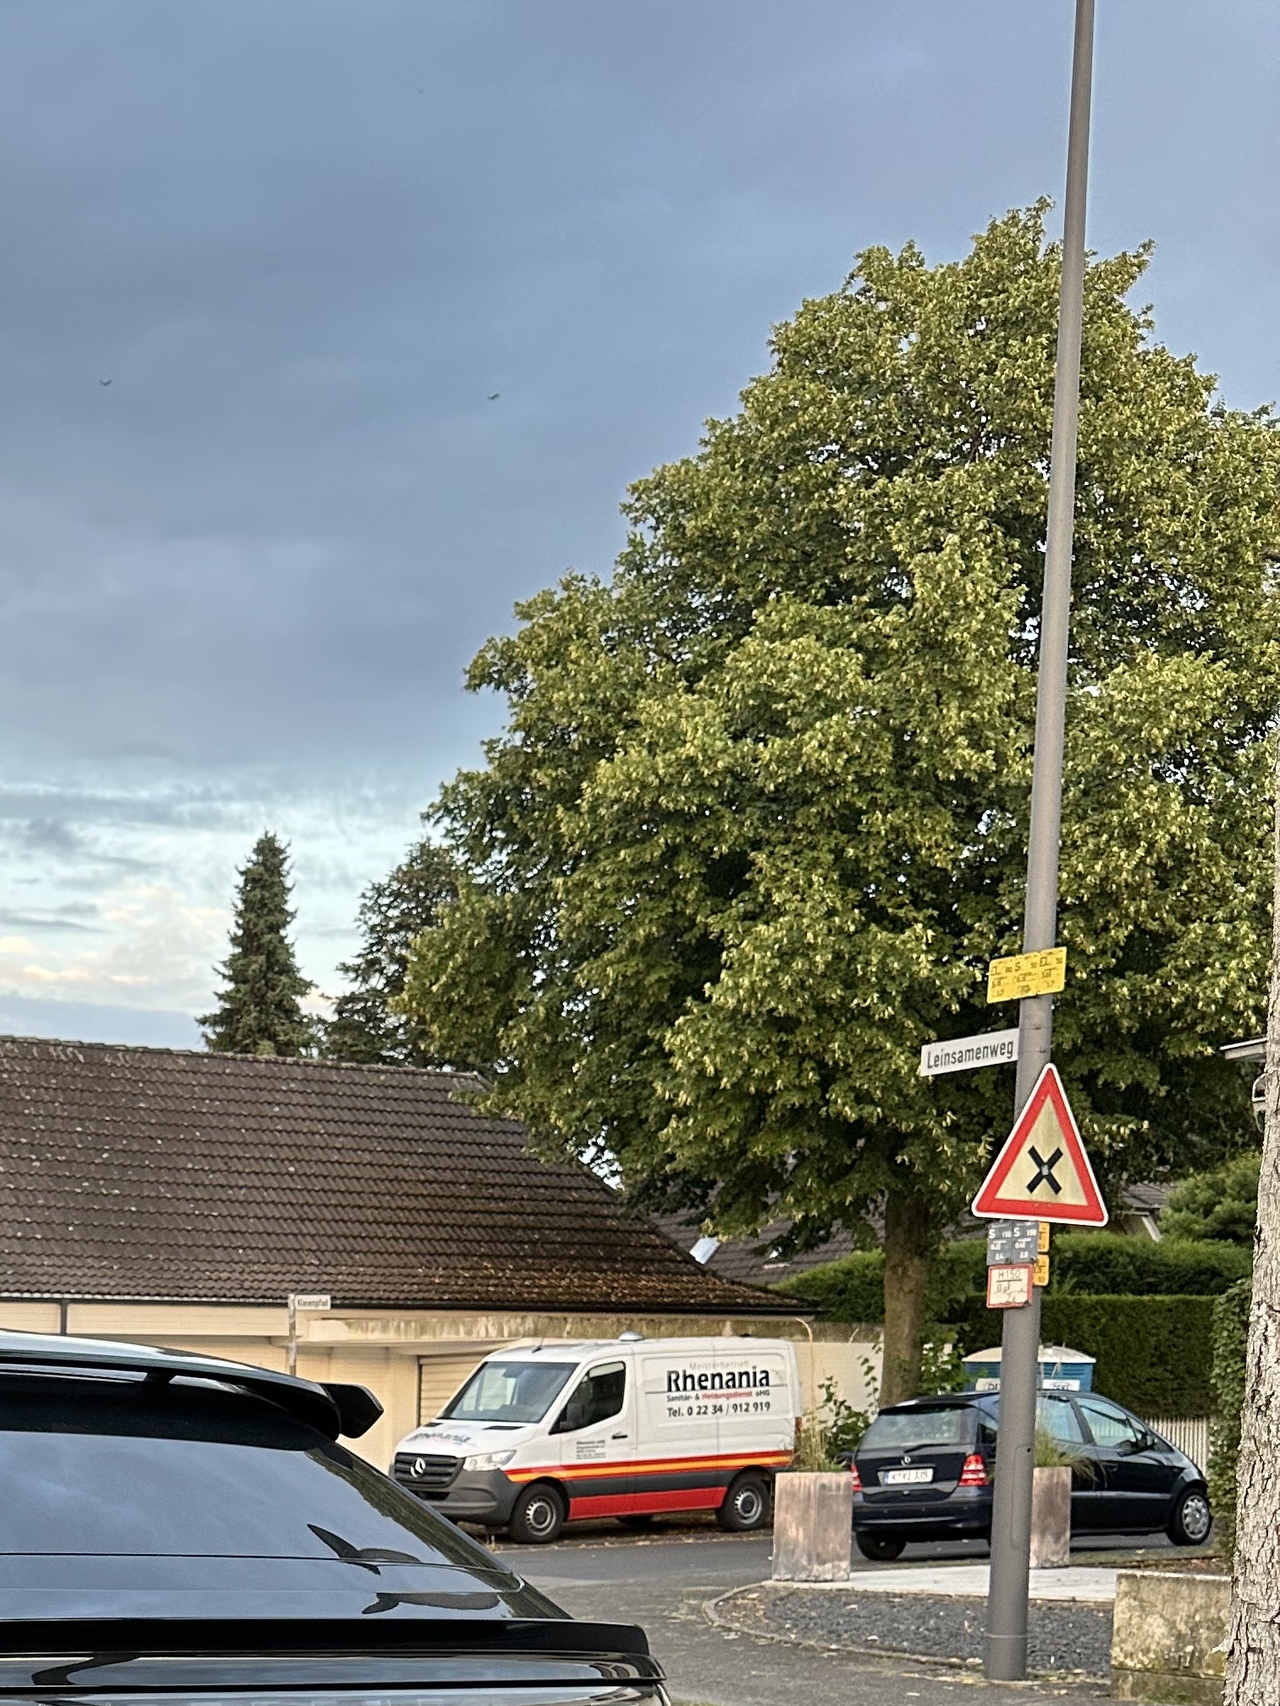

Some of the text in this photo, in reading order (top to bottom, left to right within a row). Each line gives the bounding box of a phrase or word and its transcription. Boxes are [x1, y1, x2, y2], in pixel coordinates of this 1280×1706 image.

[927, 1040, 1014, 1069] Leinsamenweg
[666, 1365, 770, 1392] Rhenania
[666, 1393, 693, 1402] Sanitär-
[694, 1393, 700, 1401] &
[667, 1407, 684, 1417] Tel.
[687, 1406, 693, 1416] 0
[695, 1405, 708, 1415] 22
[711, 1404, 723, 1414] 34
[732, 1402, 750, 1412] 912
[753, 1401, 771, 1411] 919
